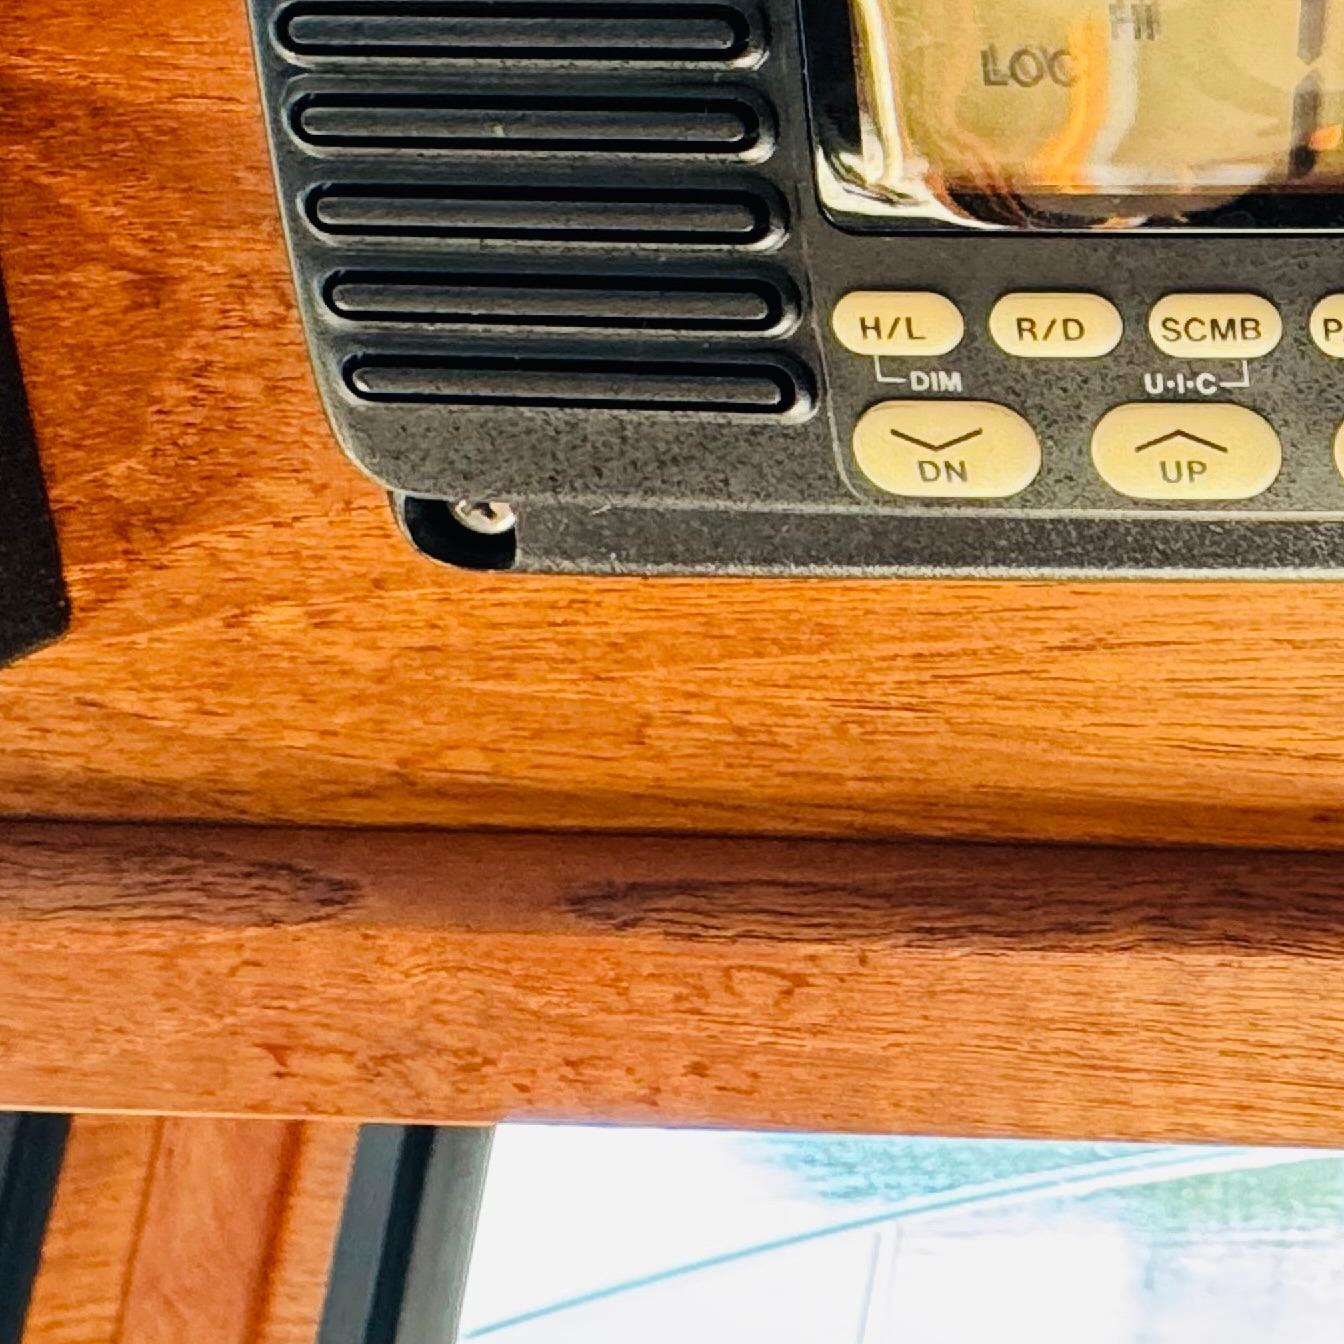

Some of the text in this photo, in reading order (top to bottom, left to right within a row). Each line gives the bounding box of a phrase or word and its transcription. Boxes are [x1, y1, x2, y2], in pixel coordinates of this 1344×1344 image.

[980, 44, 1078, 88] LOC
[859, 315, 927, 341] H/L
[1015, 316, 1086, 342] R/D
[1160, 317, 1263, 343] SCMB
[909, 370, 963, 393] DIM
[917, 459, 969, 483] DN
[1158, 459, 1209, 484] UP
